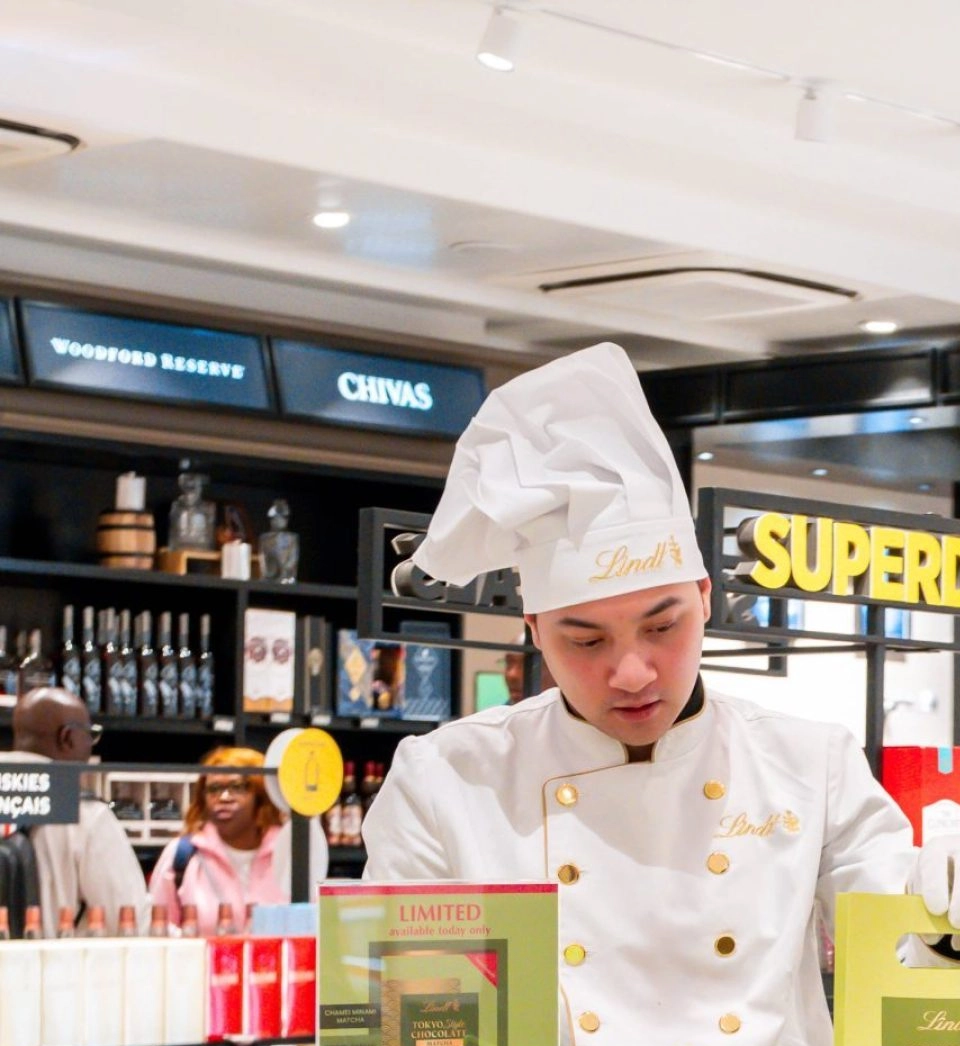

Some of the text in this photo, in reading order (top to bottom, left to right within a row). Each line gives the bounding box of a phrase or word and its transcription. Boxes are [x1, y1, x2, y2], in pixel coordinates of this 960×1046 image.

[50, 337, 245, 380] WOODFORD RESERVE
[337, 371, 433, 410] CHIVAS
[589, 542, 667, 582] Lindt
[0, 773, 50, 792] SKIES
[0, 796, 50, 819] NÇAIS
[712, 813, 781, 839] Lindt
[400, 904, 482, 922] LIMITED
[388, 924, 492, 937] available today only
[411, 1029, 467, 1039] CHOCOLATE
[413, 1020, 444, 1029] TOKYO
